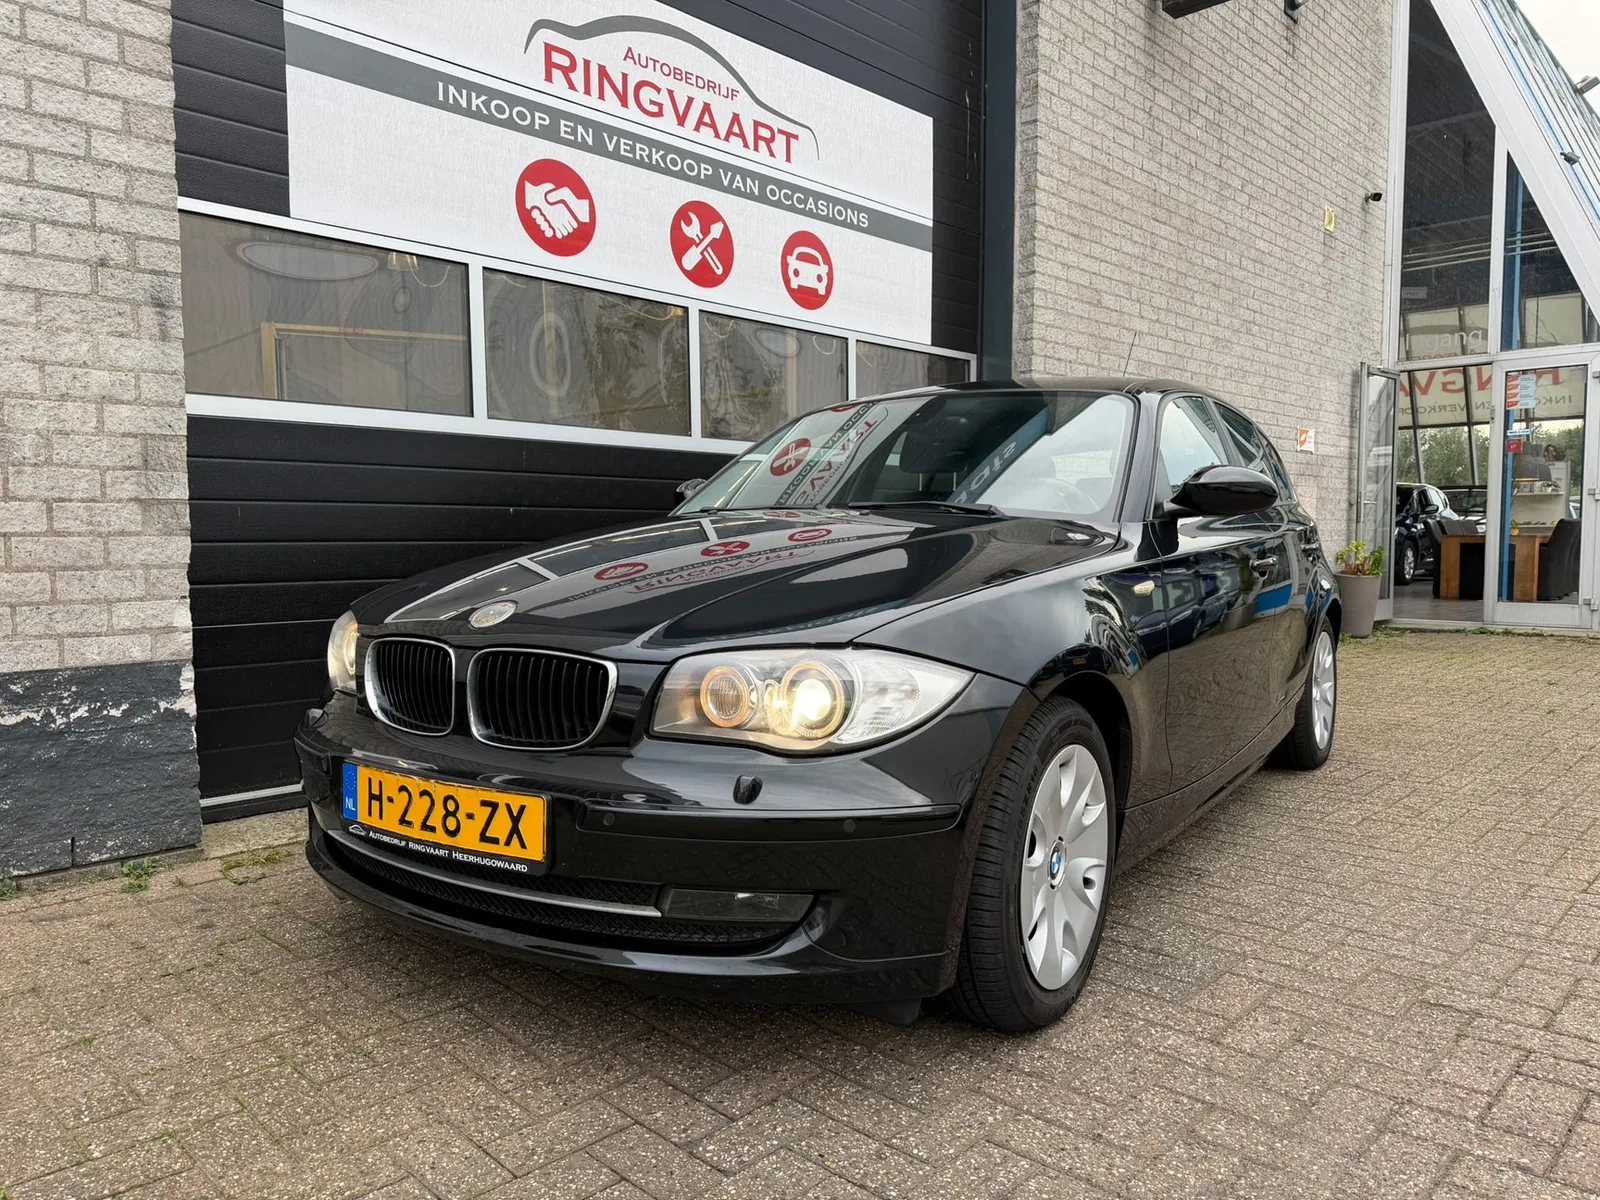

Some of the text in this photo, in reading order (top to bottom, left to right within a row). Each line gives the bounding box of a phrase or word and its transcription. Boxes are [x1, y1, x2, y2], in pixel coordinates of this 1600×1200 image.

[543, 41, 799, 164] RINGVAART
[622, 46, 740, 101] AUTOBEDRIJF
[437, 81, 869, 228] INKOOP EN VERKOOP VAN OCCASIONS
[345, 798, 356, 811] NL
[367, 776, 528, 850] H-228-ZX
[368, 830, 407, 847] AUTOBEDRIJF
[408, 842, 450, 859] RINGVAART
[452, 850, 528, 873] HEERHUGOWAARD
